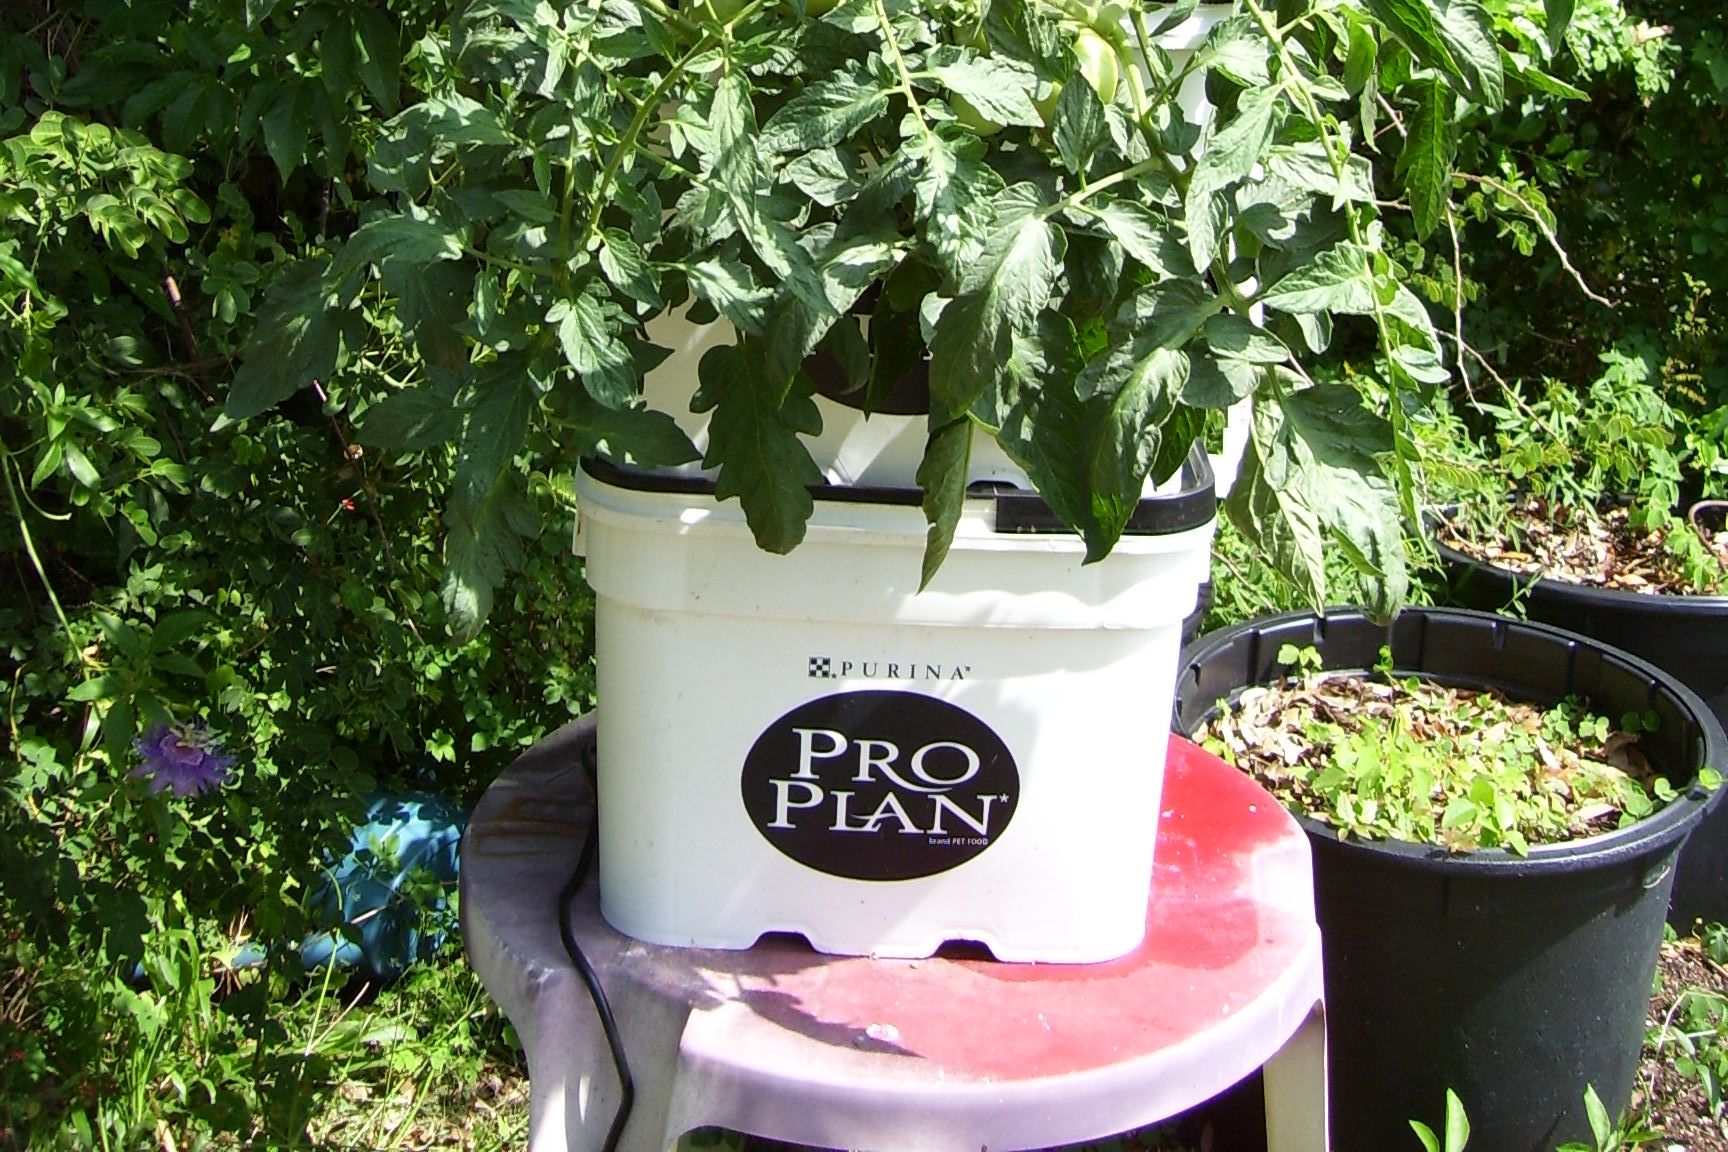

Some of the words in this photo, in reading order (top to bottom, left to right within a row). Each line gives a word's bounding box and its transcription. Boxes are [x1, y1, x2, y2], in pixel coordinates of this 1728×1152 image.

[841, 661, 965, 680] PURINA
[790, 727, 980, 792] PRO
[767, 779, 998, 835] PLAN
[952, 837, 966, 845] PET
[967, 837, 988, 845] FOOD
